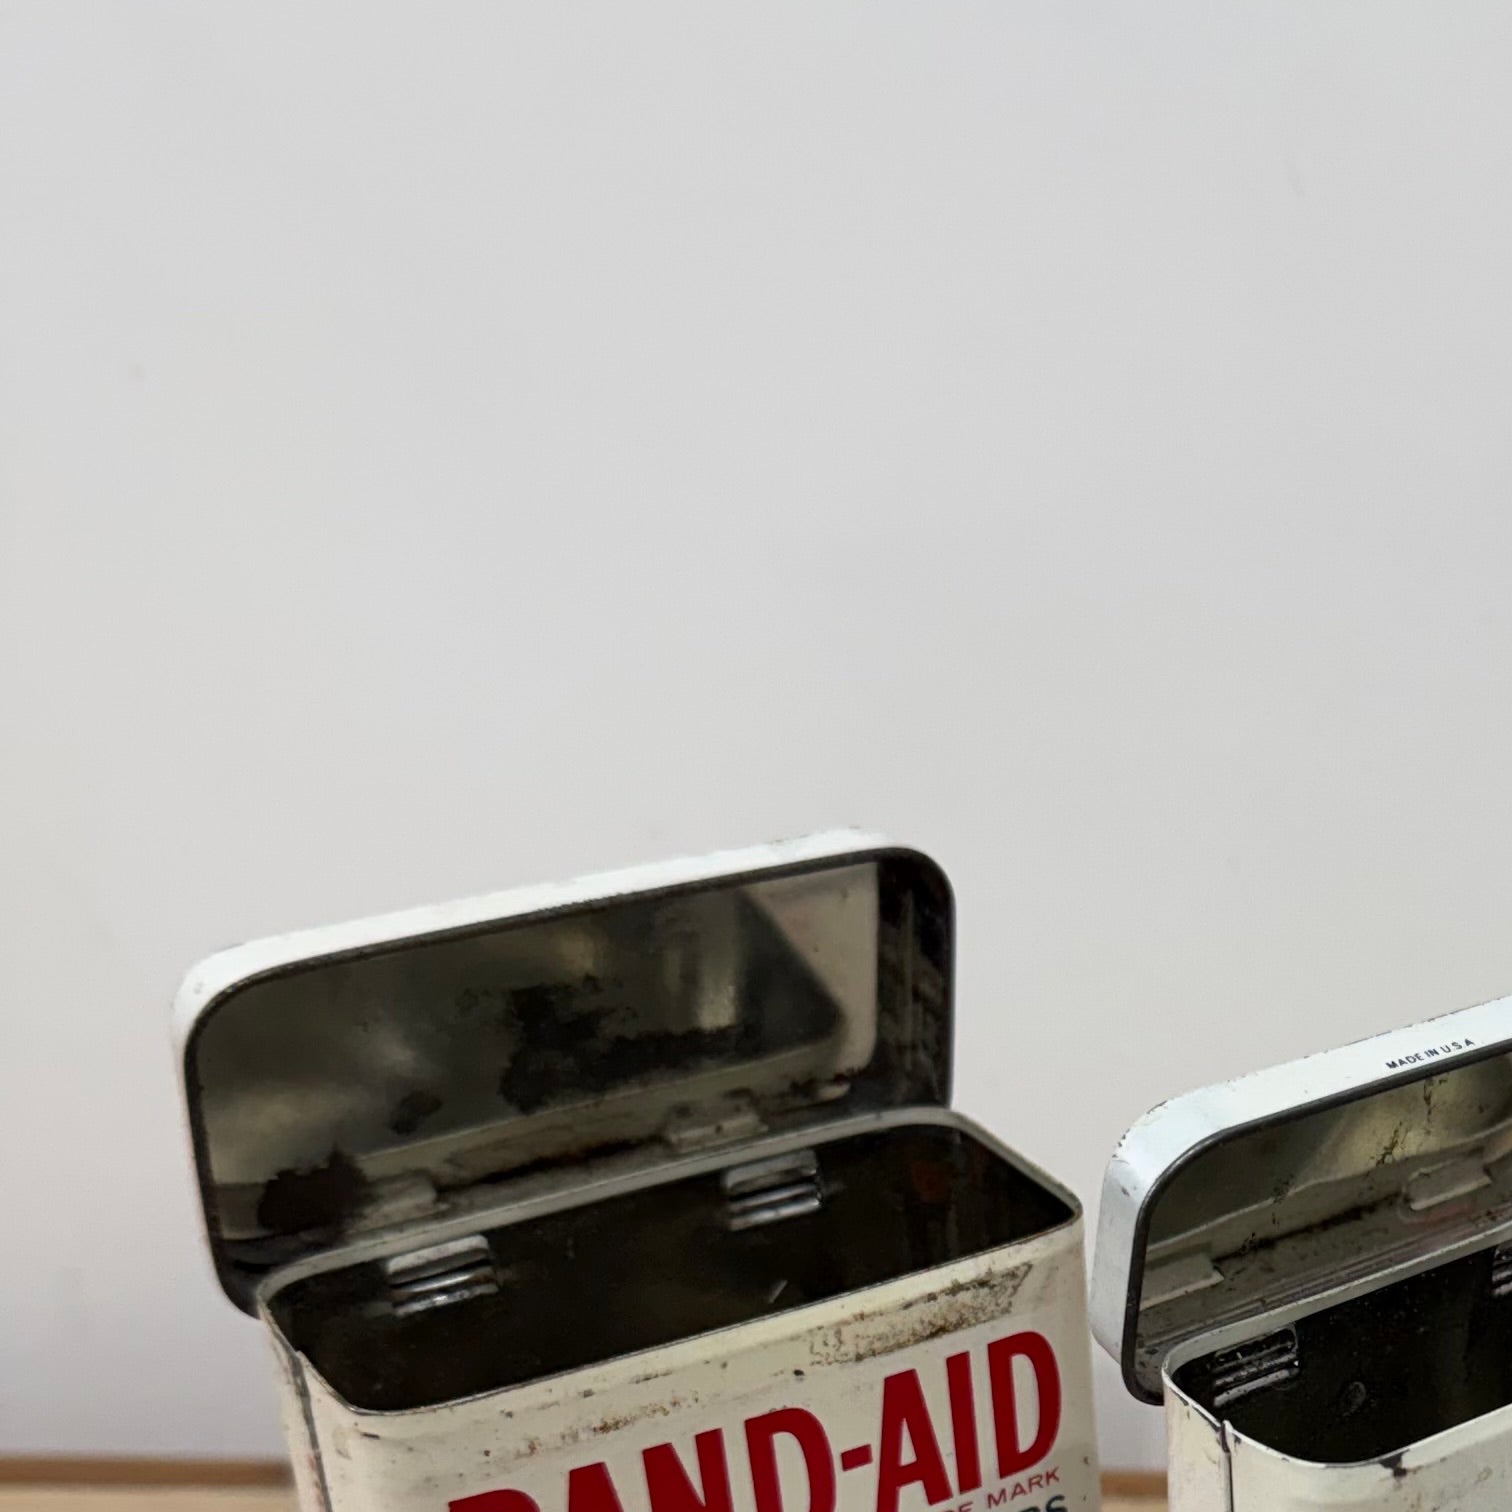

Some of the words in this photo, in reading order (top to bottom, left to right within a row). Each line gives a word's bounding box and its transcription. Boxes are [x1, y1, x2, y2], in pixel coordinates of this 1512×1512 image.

[1385, 1053, 1424, 1069] MADE
[1424, 1048, 1439, 1057] IN
[986, 1467, 1061, 1509] MARK
